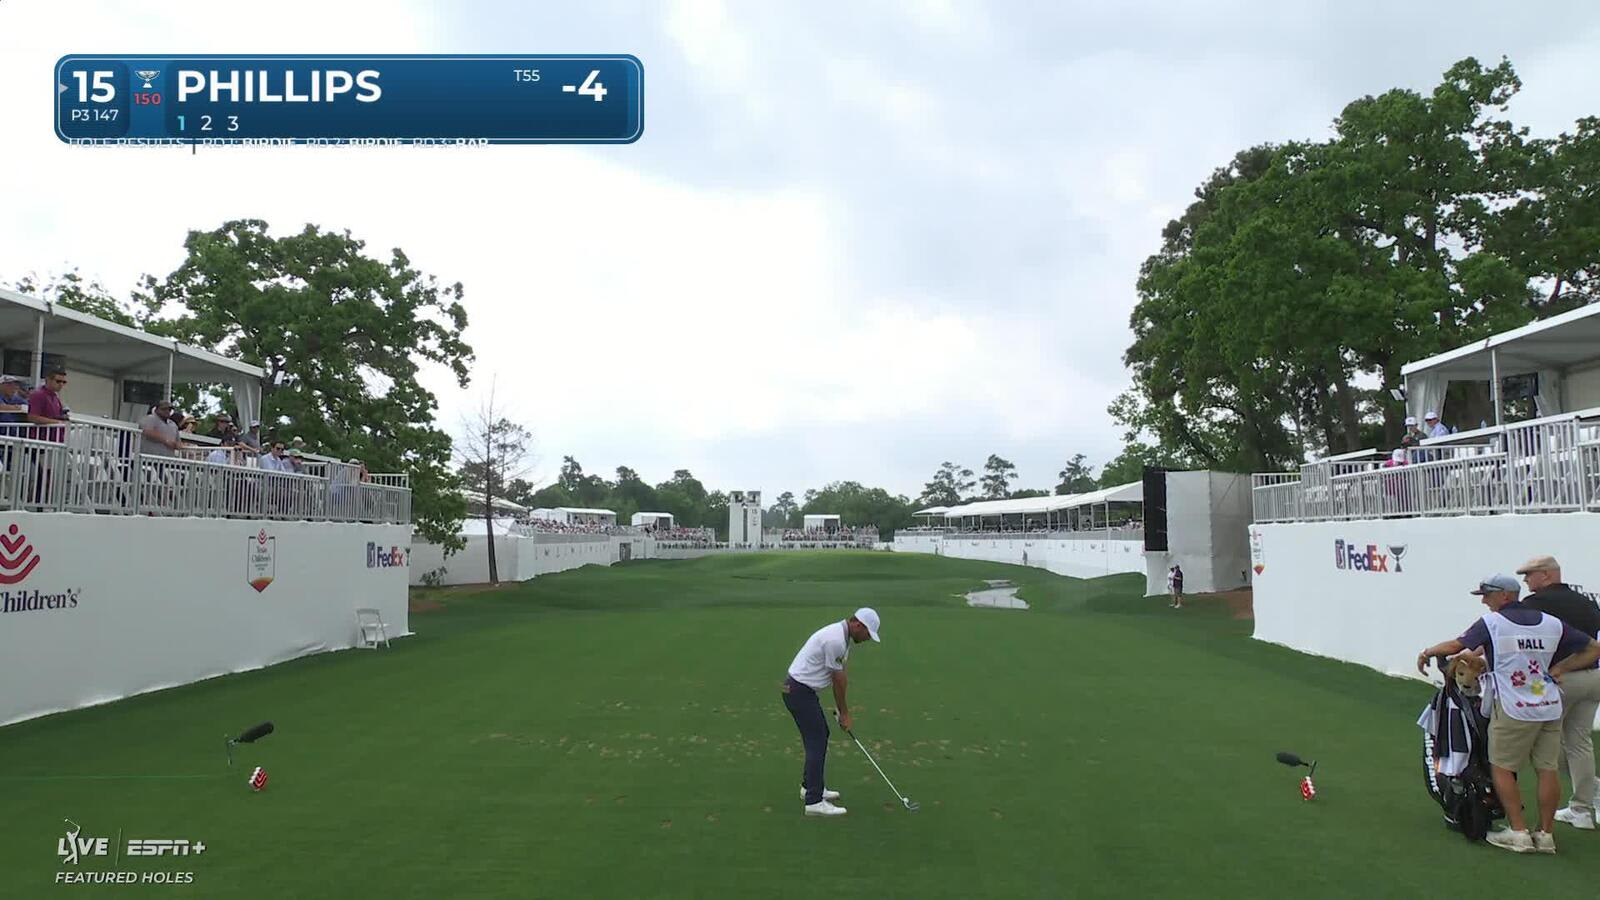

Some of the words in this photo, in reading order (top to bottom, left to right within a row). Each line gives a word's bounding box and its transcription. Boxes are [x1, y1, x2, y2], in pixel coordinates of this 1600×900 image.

[377, 546, 403, 567] FedEx
[1347, 544, 1388, 573] FedEx
[0, 588, 78, 613] hildren's
[1517, 639, 1545, 650] HALL
